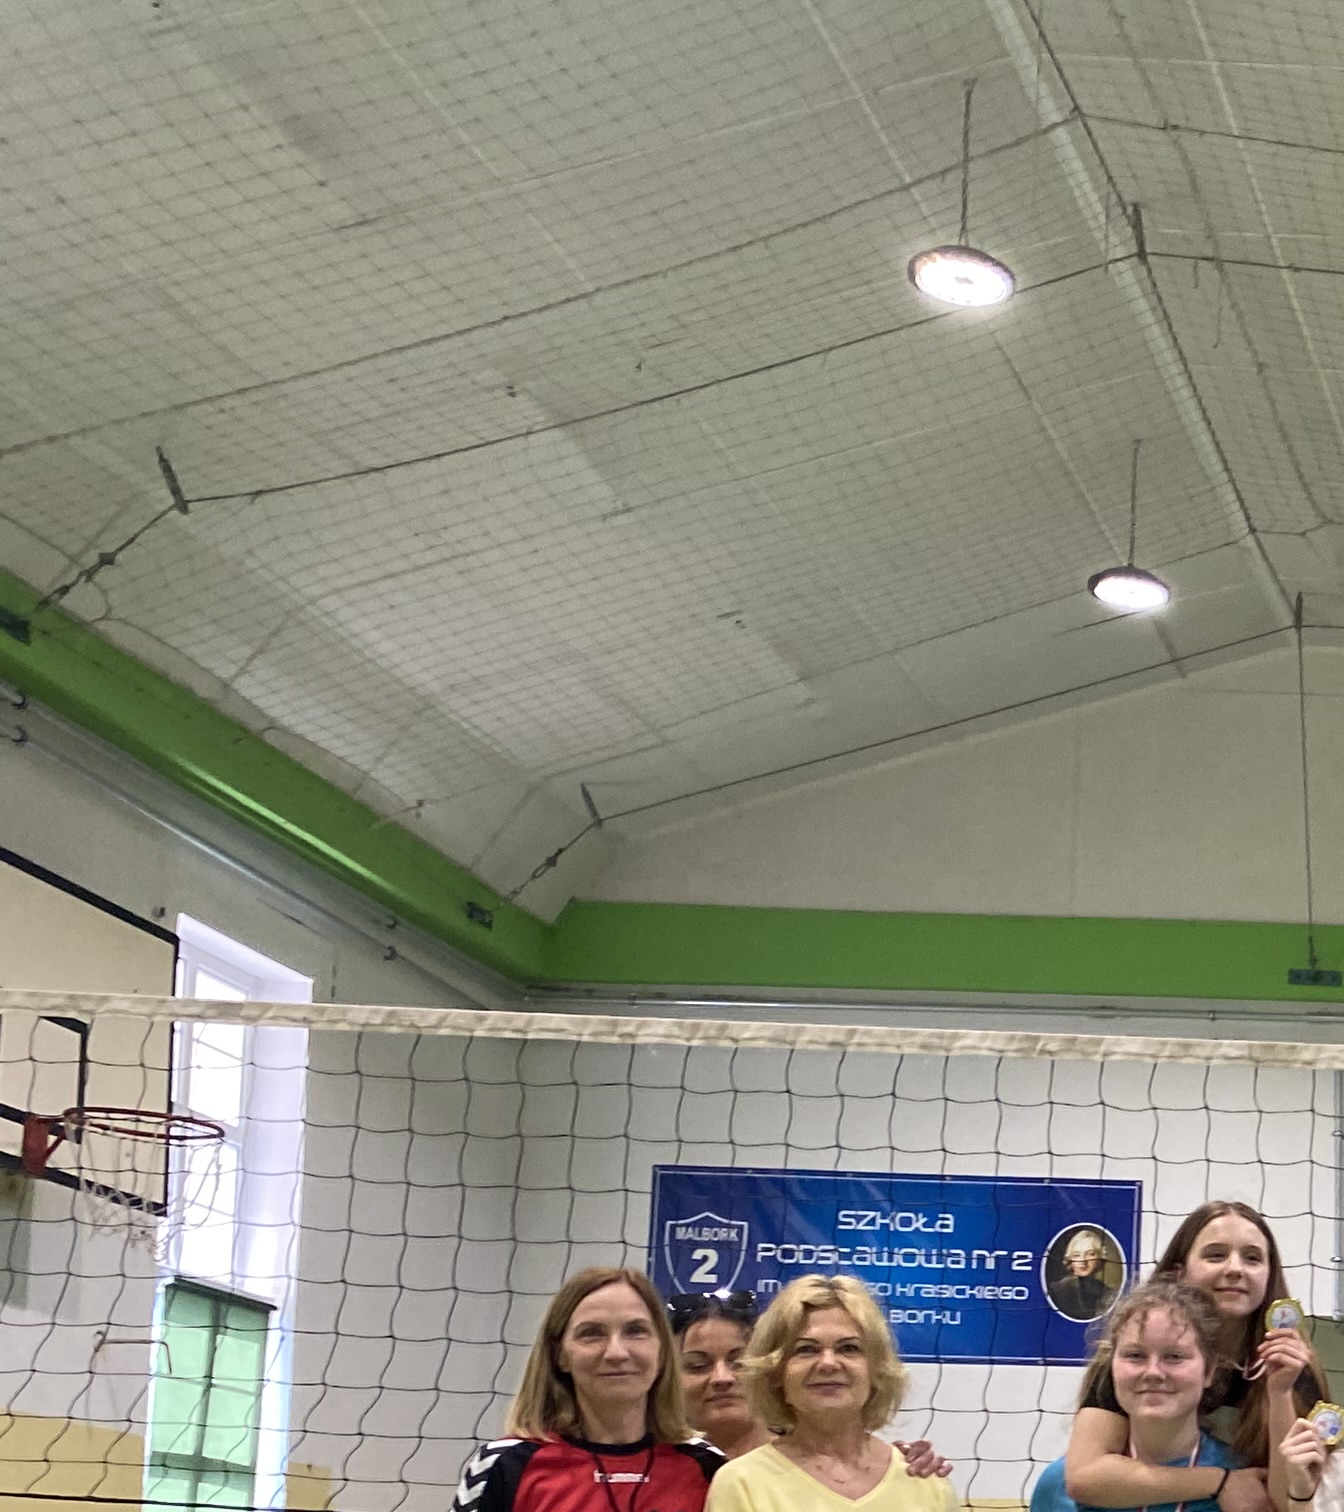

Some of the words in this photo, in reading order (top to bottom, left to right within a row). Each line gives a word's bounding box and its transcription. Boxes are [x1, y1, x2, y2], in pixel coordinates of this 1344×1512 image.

[675, 1226, 739, 1241] MALBORK
[689, 1248, 719, 1284] 2
[1011, 1250, 1033, 1271] 2
